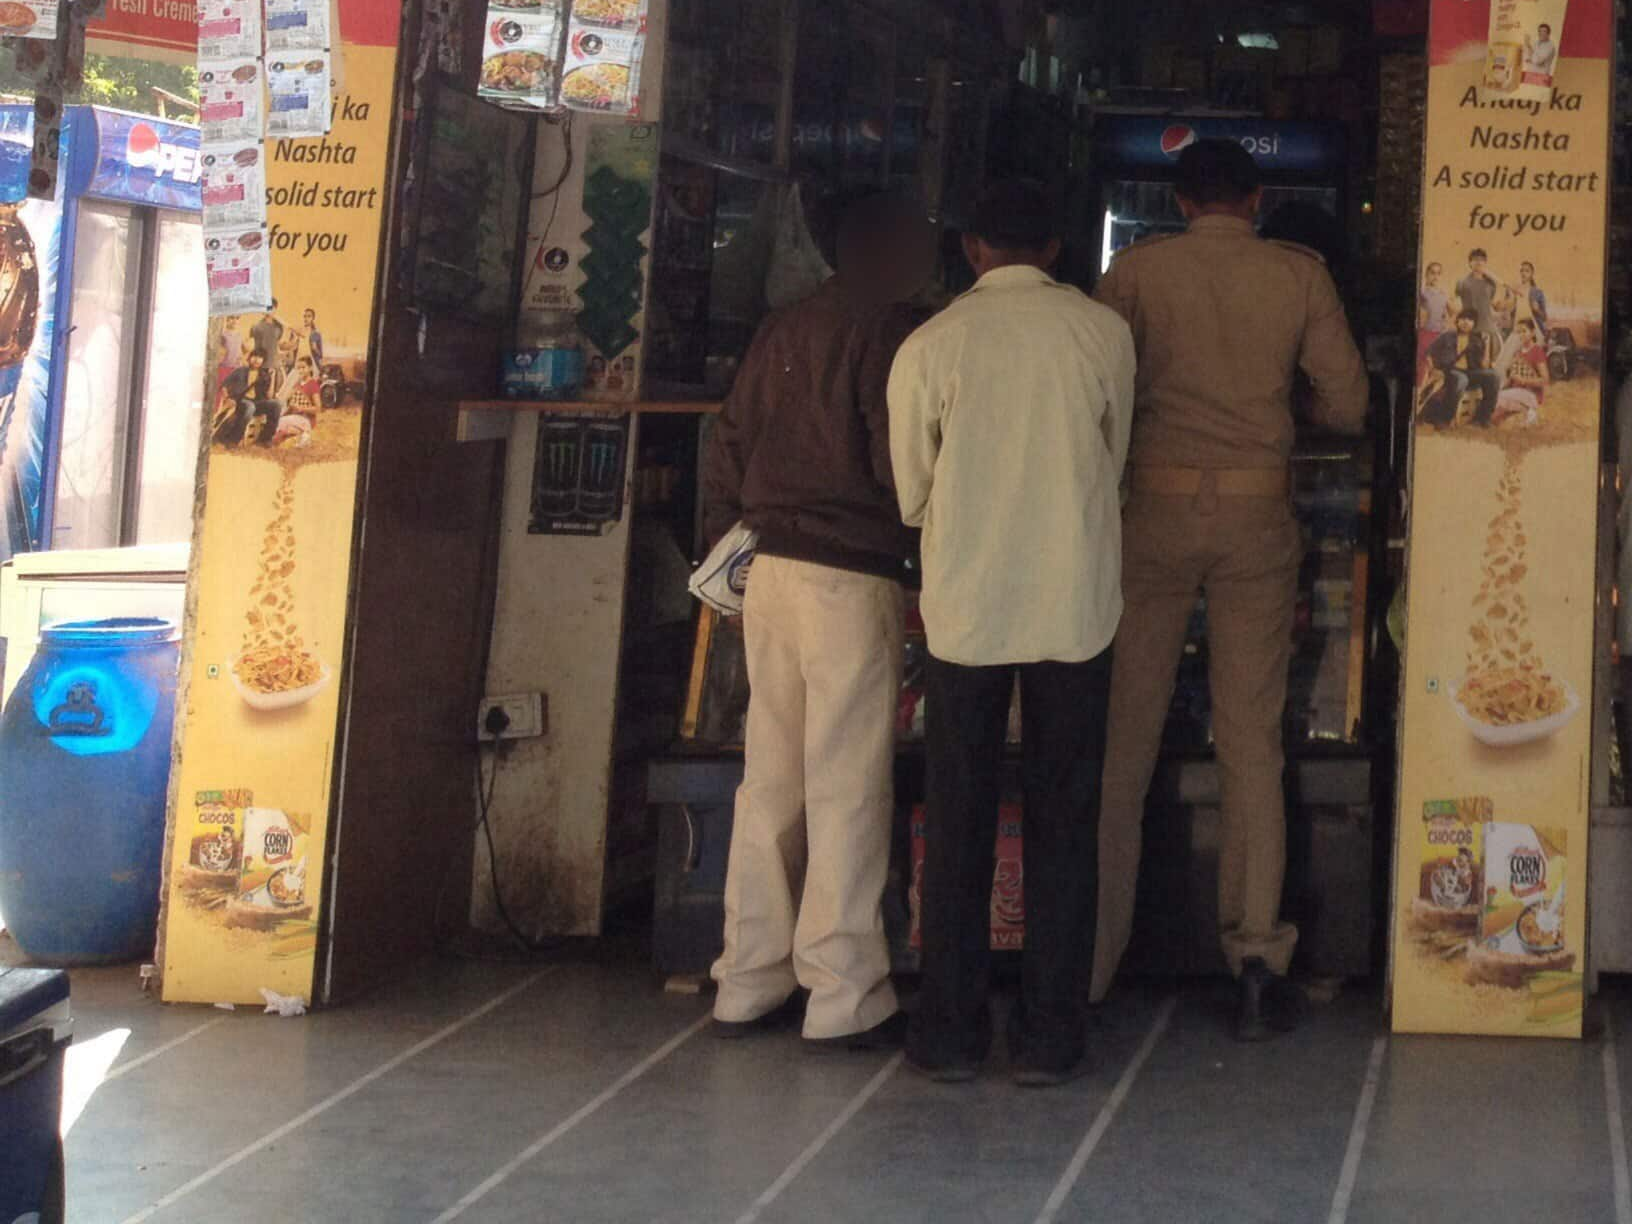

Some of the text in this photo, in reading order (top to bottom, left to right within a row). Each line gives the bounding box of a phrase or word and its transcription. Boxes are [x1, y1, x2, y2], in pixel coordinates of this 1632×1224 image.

[342, 96, 369, 122] ka
[1549, 86, 1583, 112] ka
[274, 139, 357, 164] Nashta
[1470, 126, 1570, 152] Nashta
[1433, 166, 1598, 192] A solid start
[265, 181, 377, 209] solid start
[1468, 205, 1567, 237] for you
[268, 224, 348, 258] for you
[198, 813, 236, 825] CHOCOS
[264, 832, 290, 847] CORN
[1510, 853, 1542, 875] CORN
